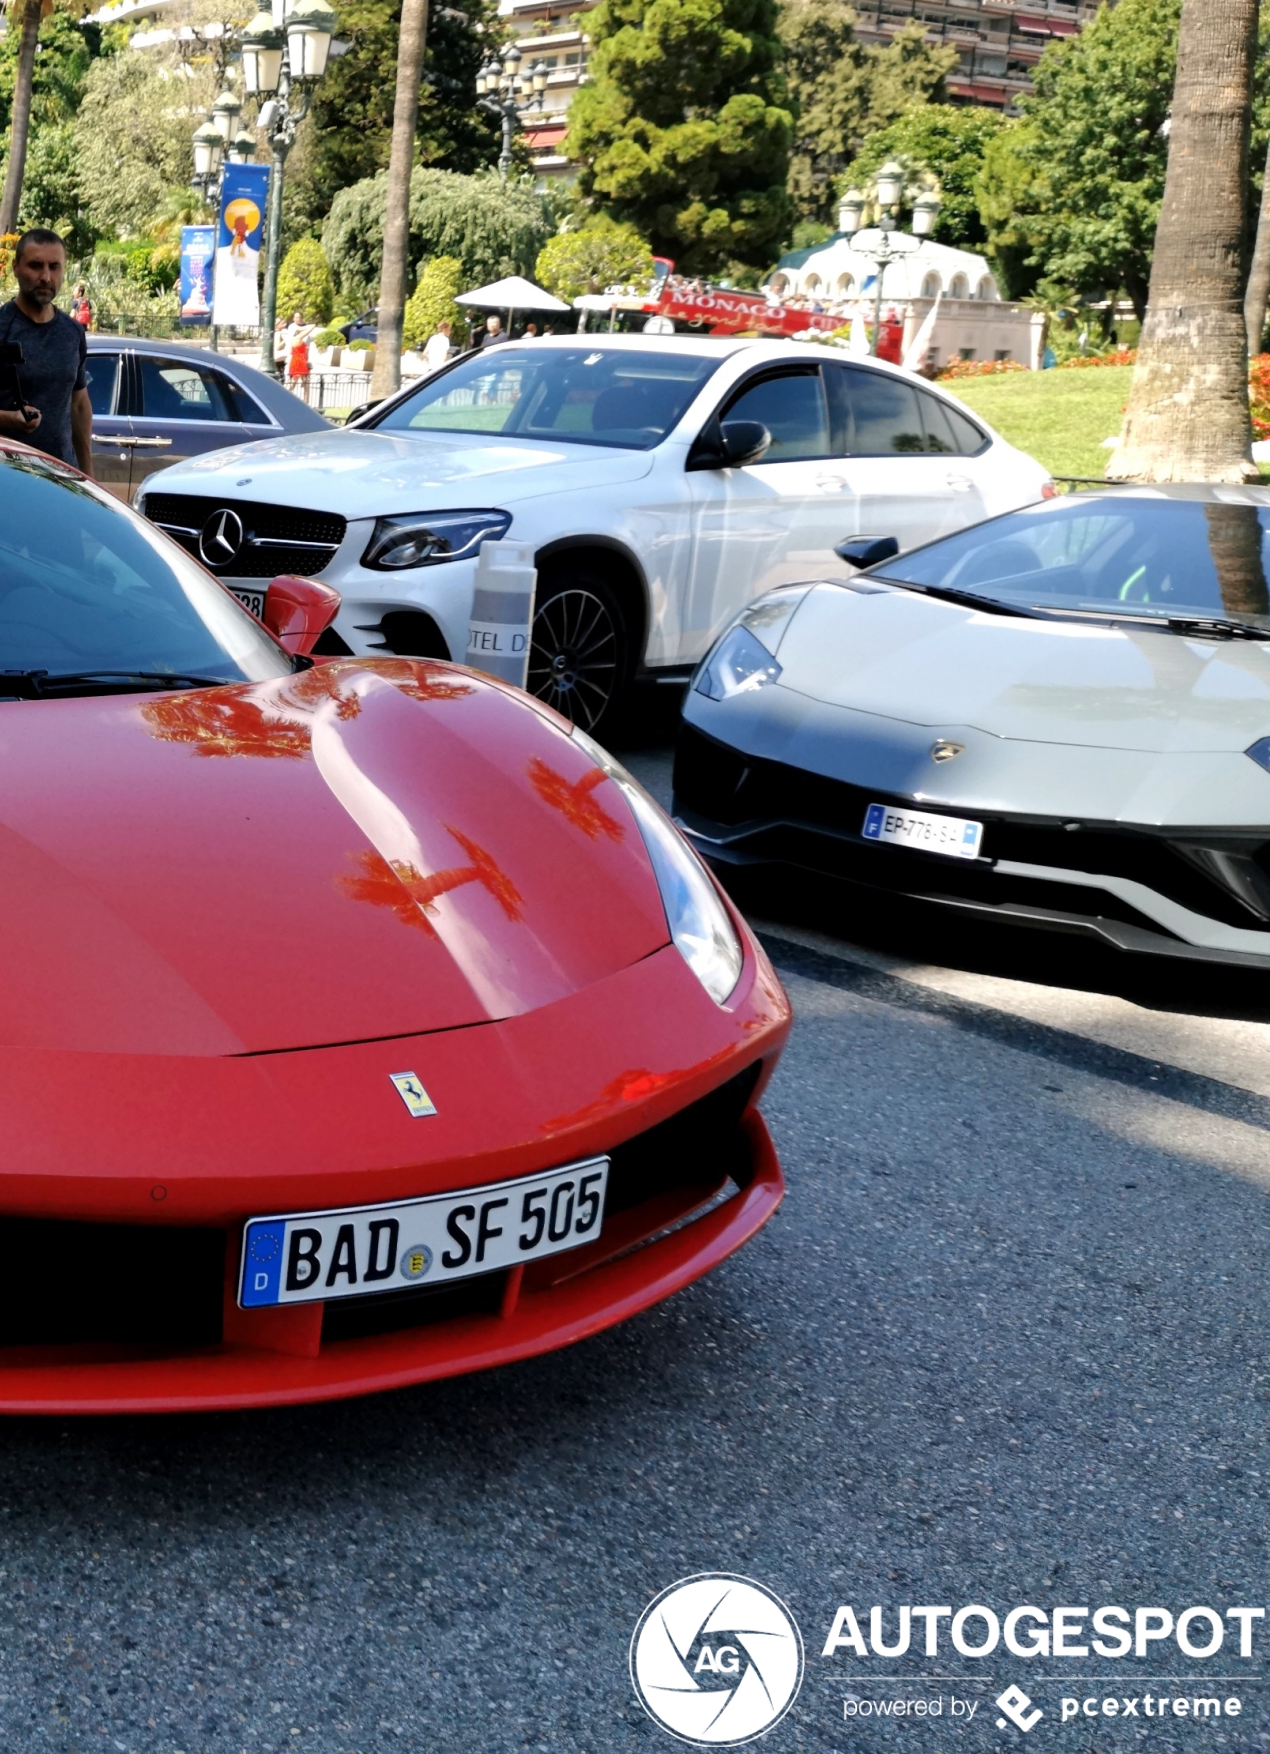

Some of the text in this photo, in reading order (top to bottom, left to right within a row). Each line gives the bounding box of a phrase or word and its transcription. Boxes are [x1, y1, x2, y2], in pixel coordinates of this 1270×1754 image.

[671, 292, 787, 319] MONACO
[285, 1172, 603, 1292] BAD SF 505
[254, 1273, 268, 1291] D
